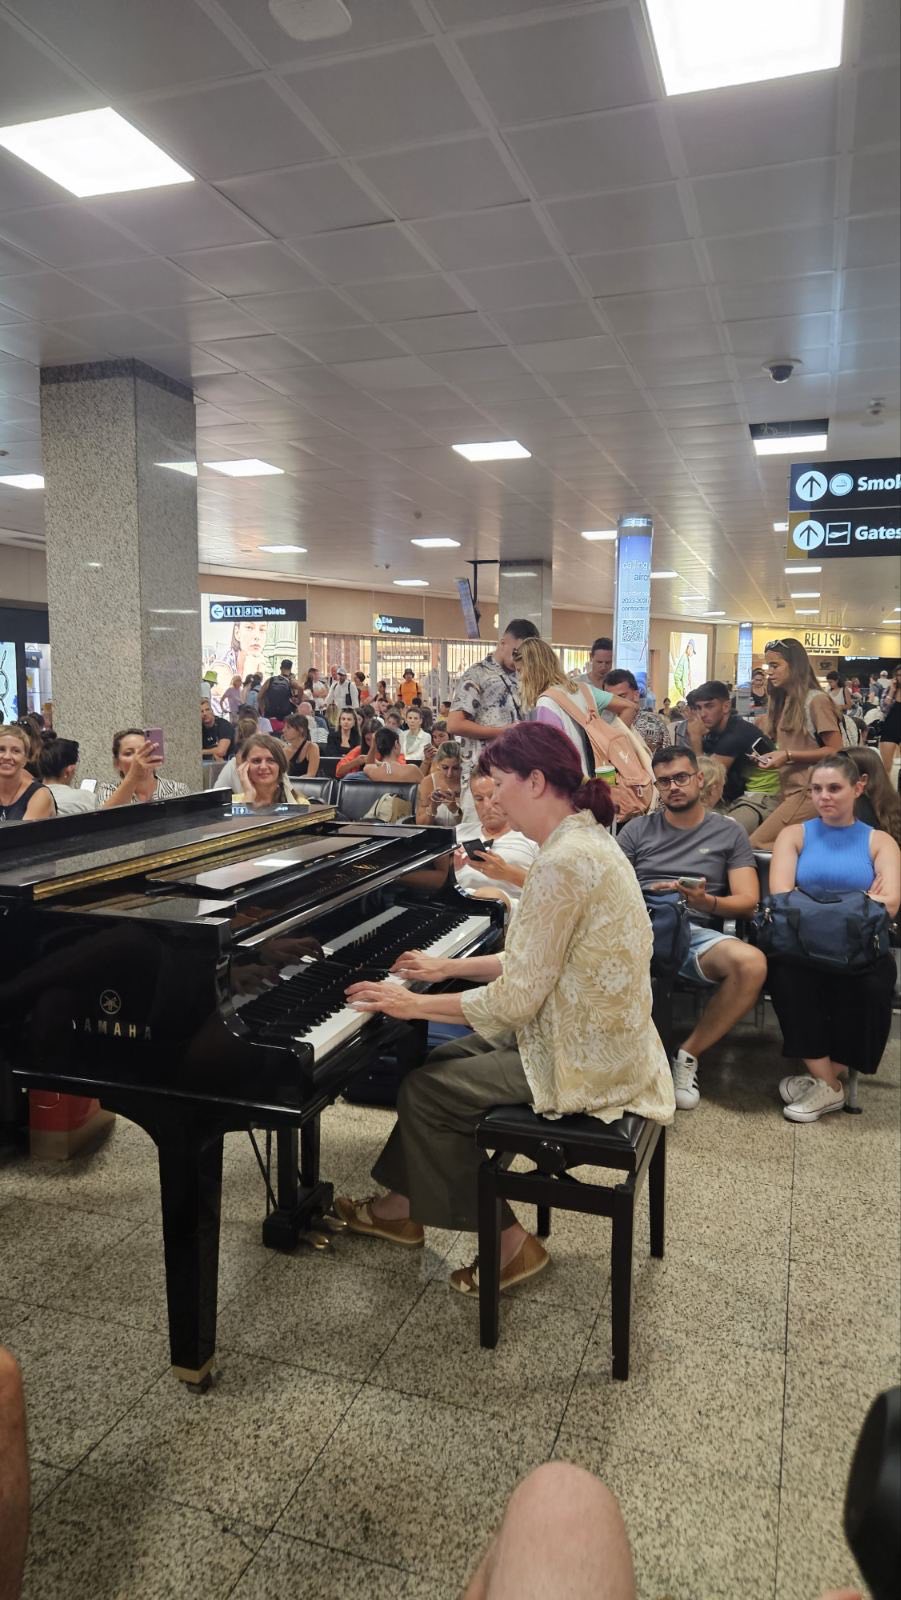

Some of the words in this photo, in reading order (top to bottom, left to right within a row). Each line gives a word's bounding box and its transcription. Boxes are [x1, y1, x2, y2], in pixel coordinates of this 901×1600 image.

[855, 525, 901, 540] Gates
[264, 607, 286, 616] Toilets
[804, 632, 841, 647] RELISH
